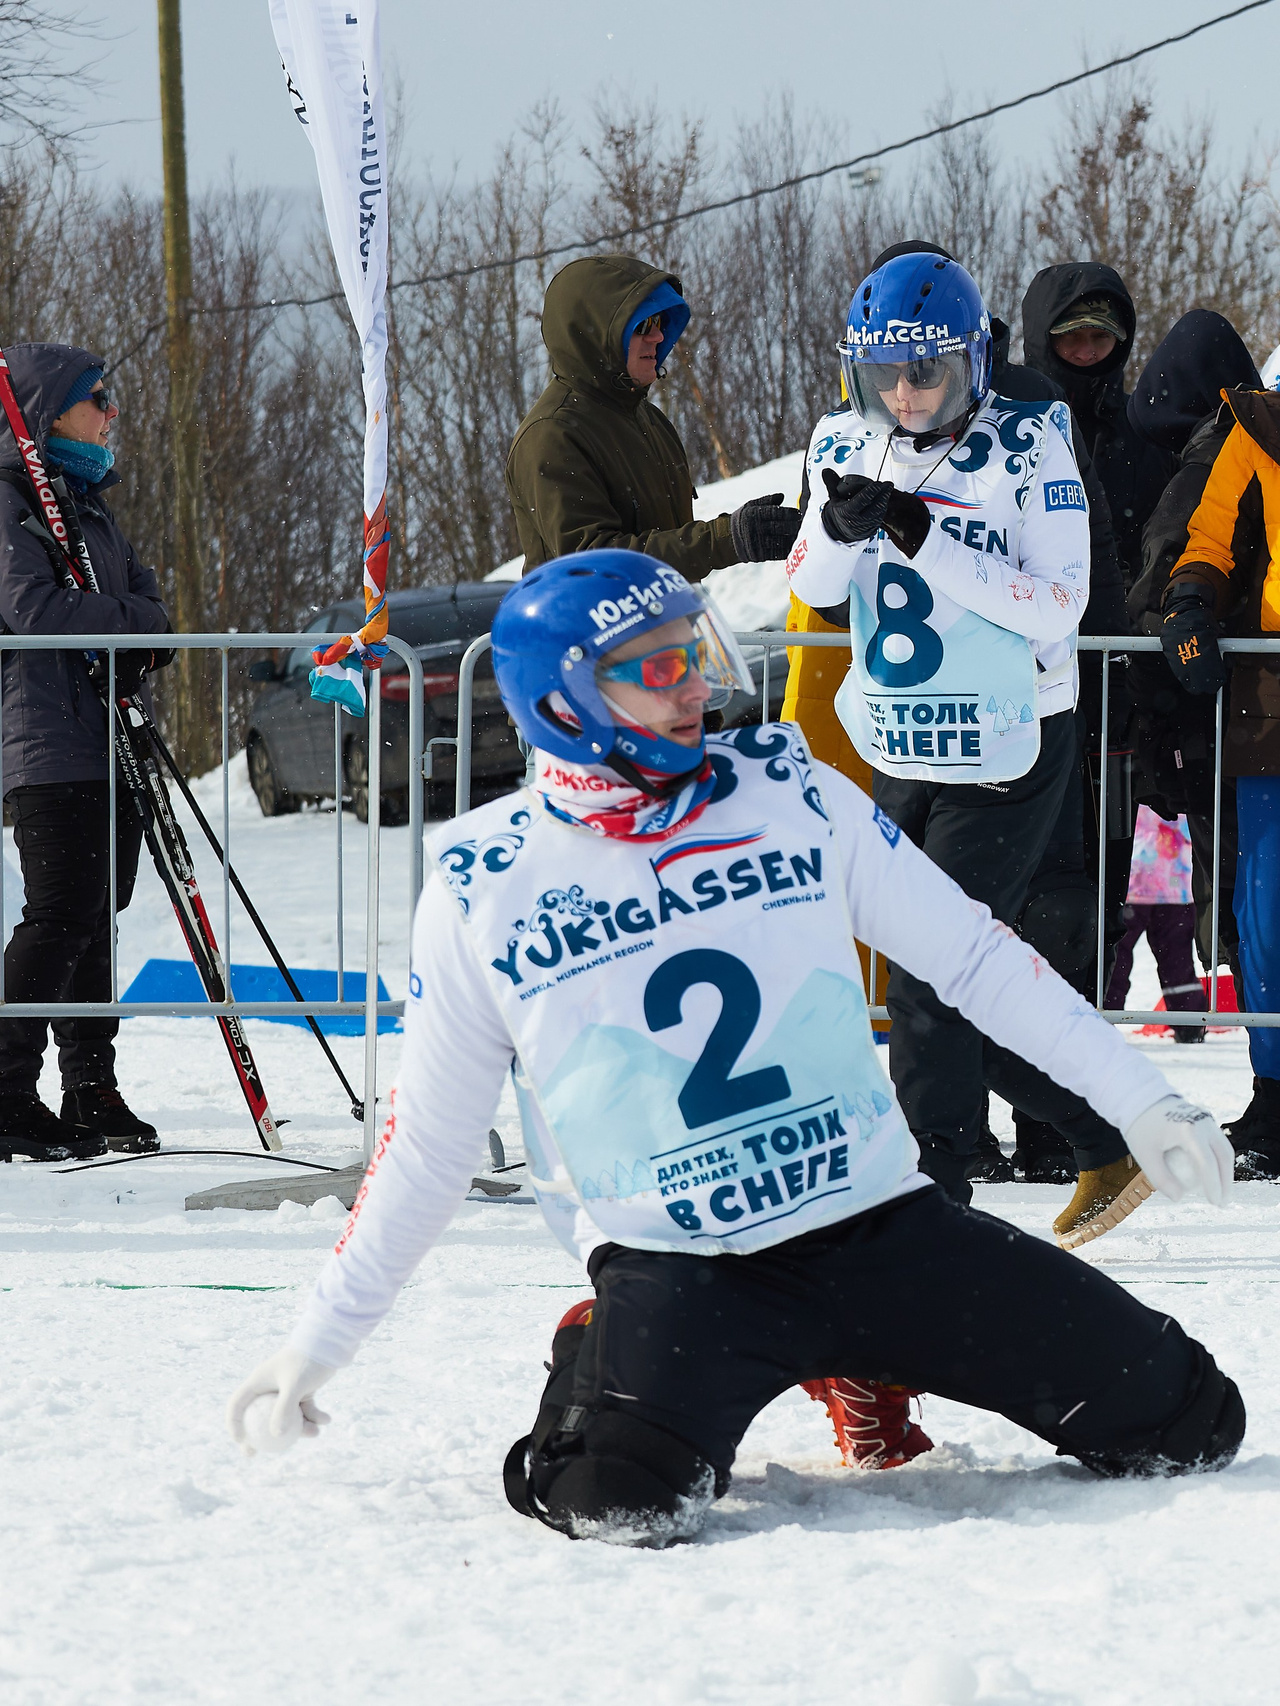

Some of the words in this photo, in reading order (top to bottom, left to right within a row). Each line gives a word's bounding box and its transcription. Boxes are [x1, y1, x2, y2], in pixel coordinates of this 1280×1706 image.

[18, 436, 70, 555] ORDWAY
[865, 561, 944, 689] 8
[891, 703, 980, 725] ТОЛК
[120, 734, 146, 791] NORDWAY
[977, 782, 1010, 794] NORDWAY
[556, 953, 612, 983] MURMANSK
[614, 939, 655, 960] REGION
[227, 1015, 243, 1048] COM
[643, 948, 792, 1130] 2
[657, 1159, 693, 1184] ДЛЯ
[693, 1146, 735, 1168] ТЕХ,
[741, 1108, 848, 1165] ТОЛК
[660, 1179, 690, 1197] КТО
[692, 1162, 739, 1187] ЗНАЕТ
[665, 1199, 702, 1231] В
[709, 1143, 849, 1223] СНЕГЕ
